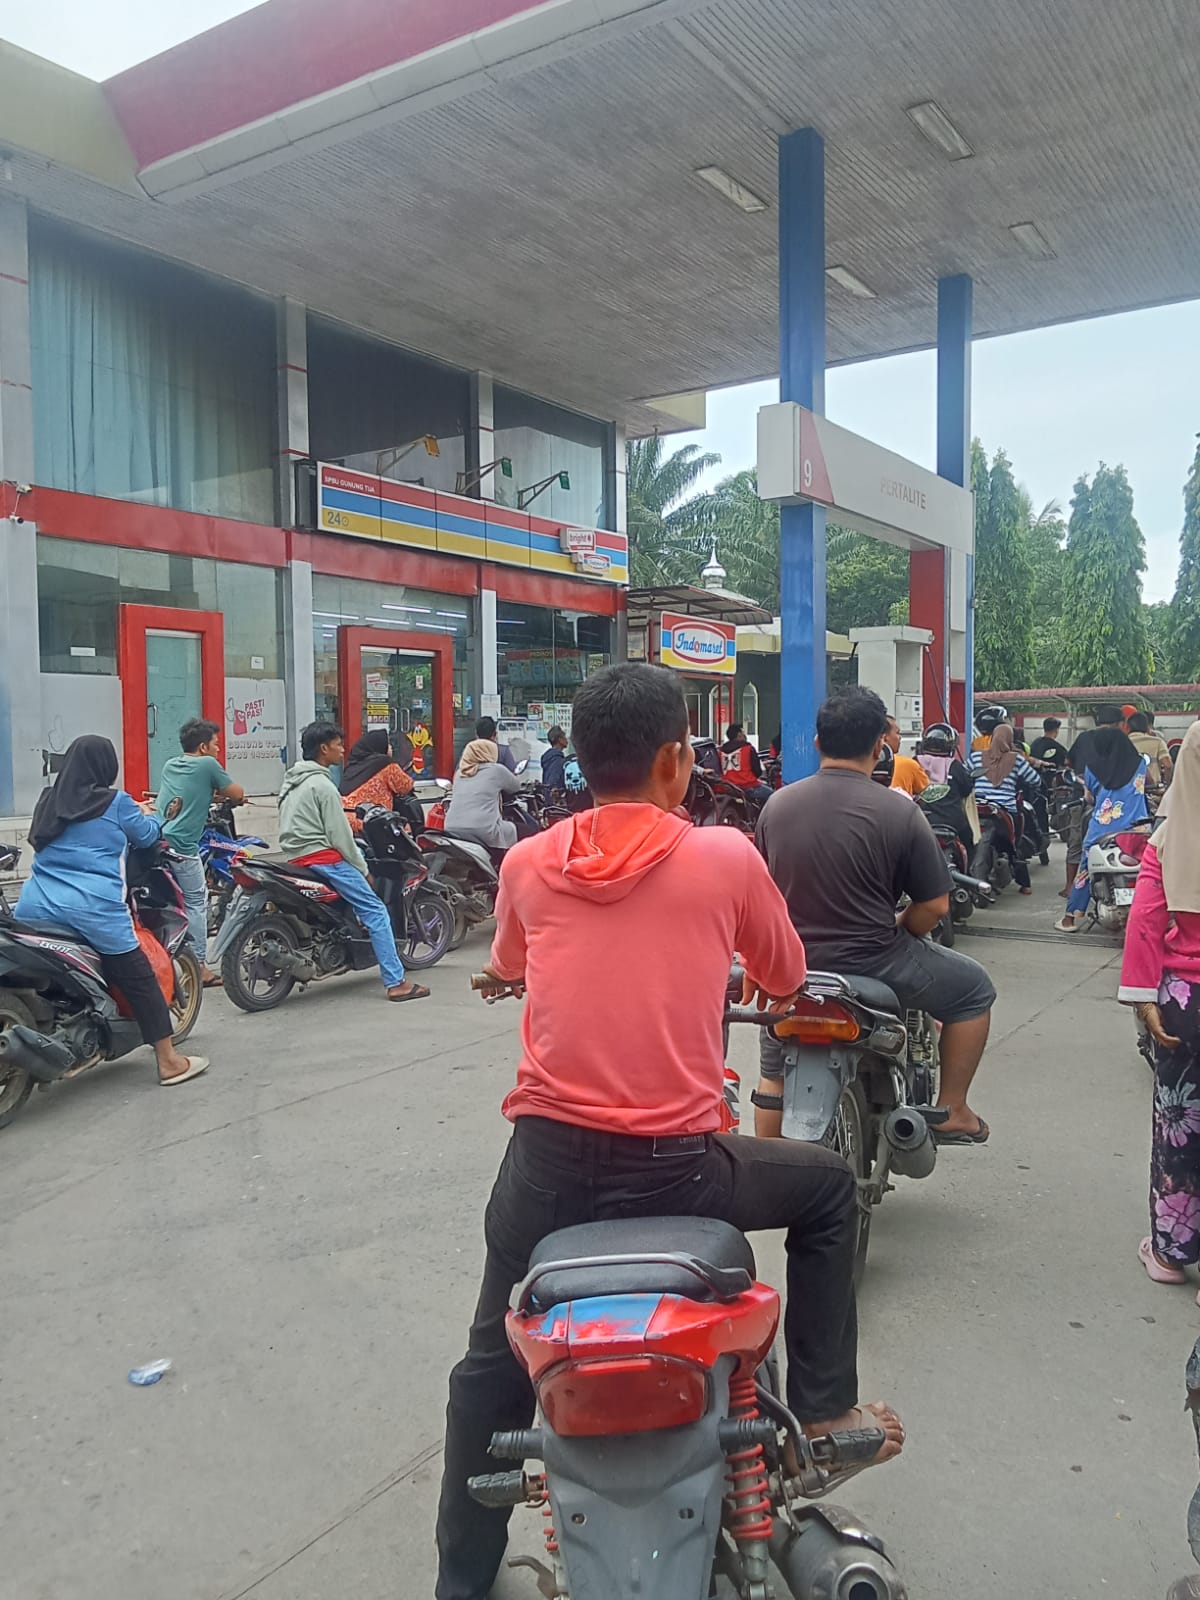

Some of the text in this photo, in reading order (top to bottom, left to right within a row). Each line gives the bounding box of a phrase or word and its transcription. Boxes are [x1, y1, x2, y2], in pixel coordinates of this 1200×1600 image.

[804, 459, 812, 488] 9
[340, 479, 364, 490] GUNUNG
[364, 485, 375, 493] TUA
[880, 476, 927, 510] PERTALITE
[327, 511, 341, 526] 24
[675, 631, 724, 655] Indomaret
[245, 699, 264, 711] PASTI
